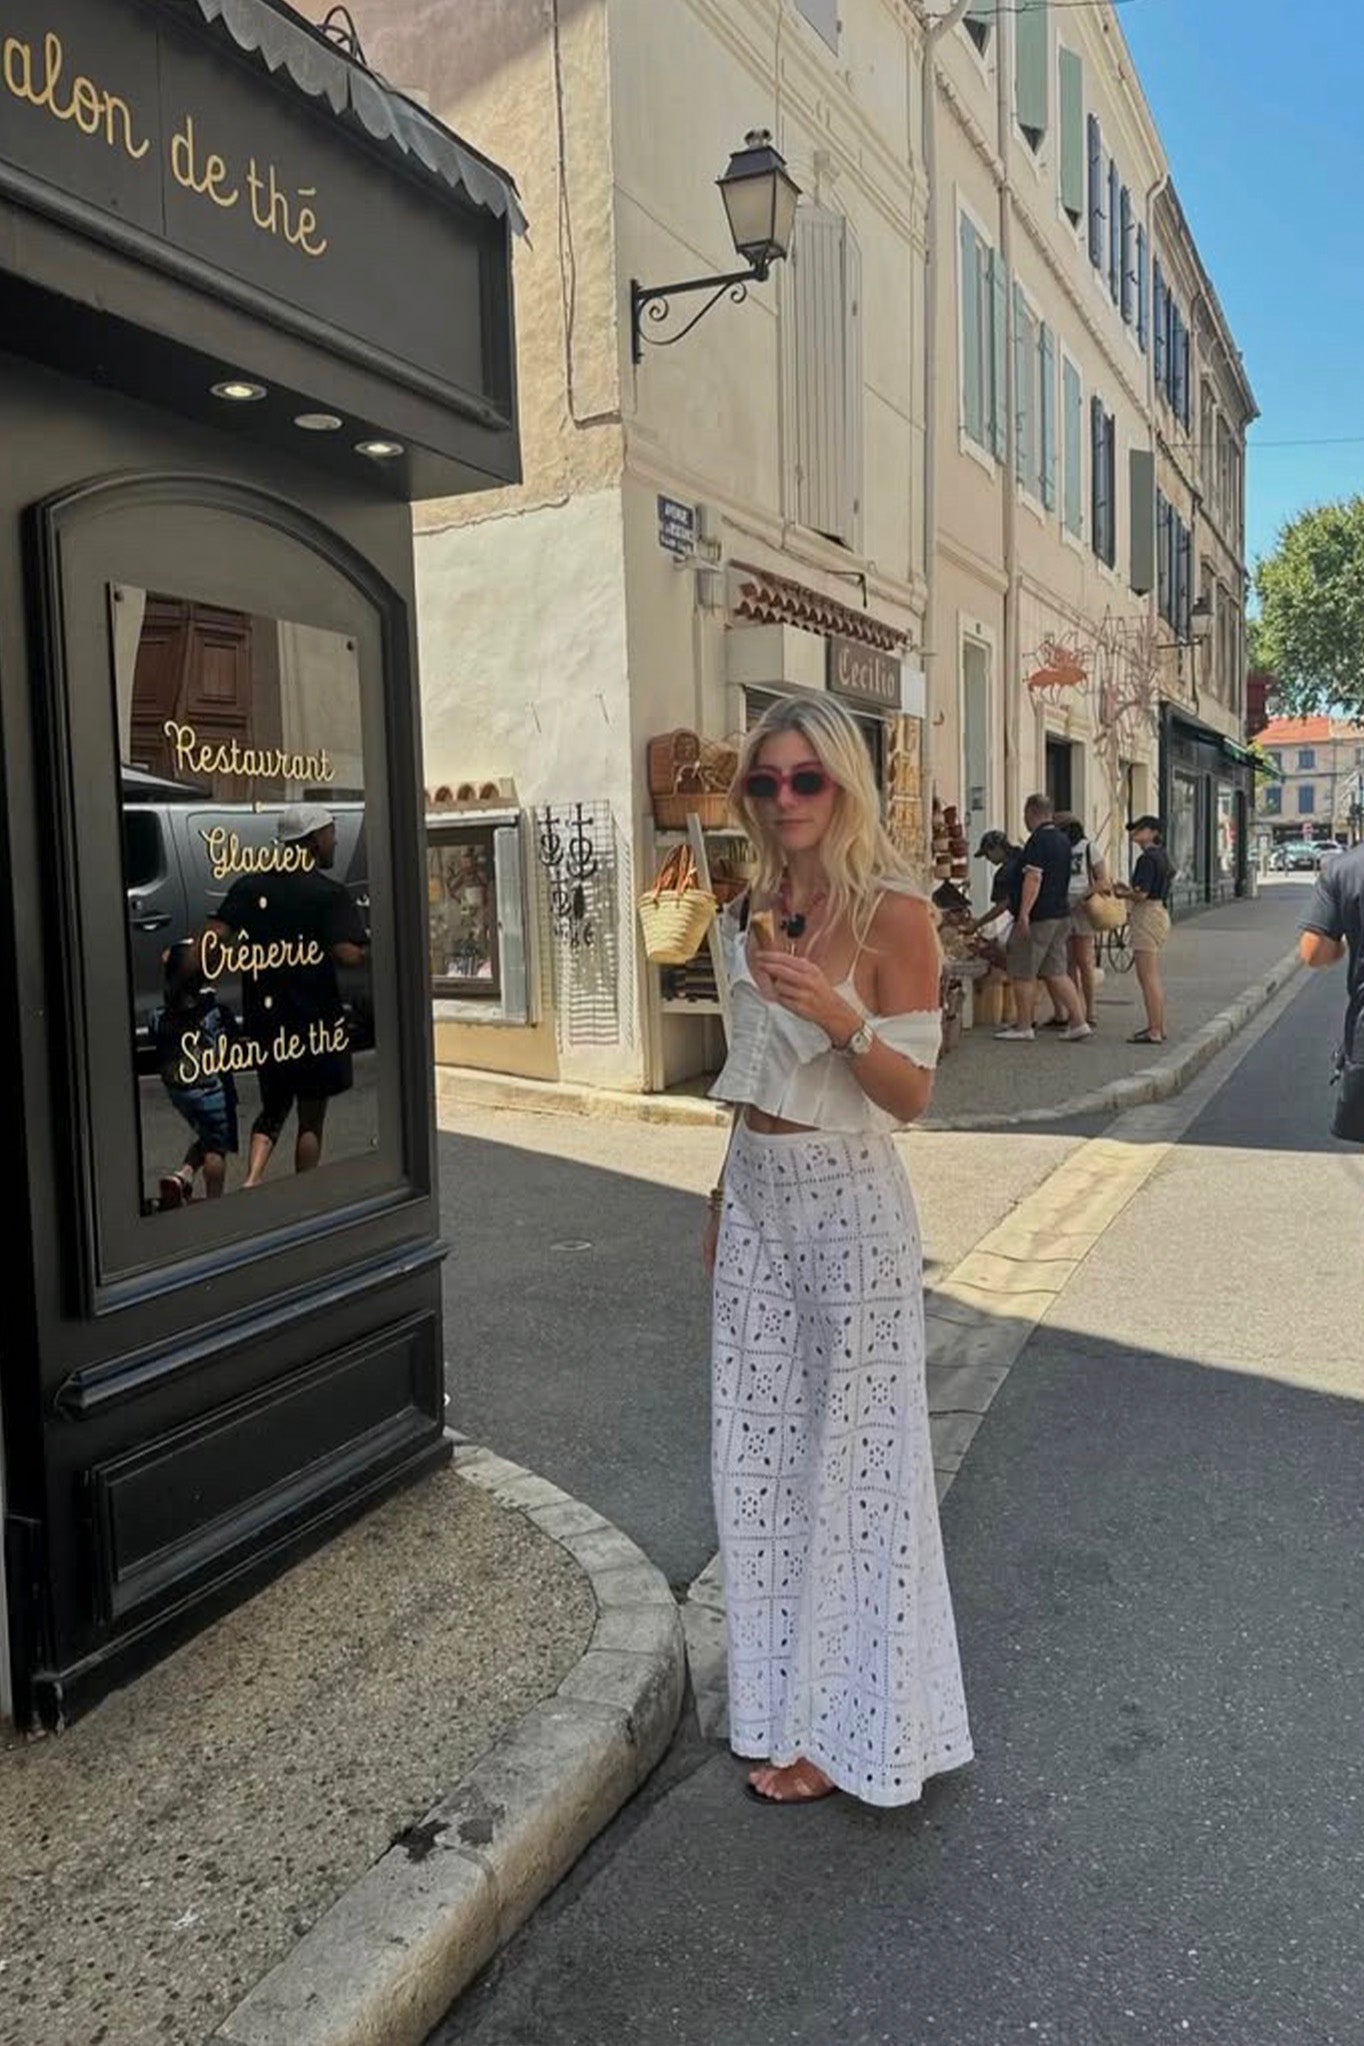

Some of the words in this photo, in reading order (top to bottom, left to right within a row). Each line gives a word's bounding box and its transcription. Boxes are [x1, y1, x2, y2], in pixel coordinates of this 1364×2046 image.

[172, 115, 239, 207] de
[247, 158, 328, 255] thé
[164, 721, 336, 782] Restaurant
[198, 826, 315, 879] Glacier
[201, 929, 324, 982] Crêperie
[179, 1030, 268, 1083] Salon
[273, 1025, 305, 1062] de
[309, 1016, 349, 1055] thé
